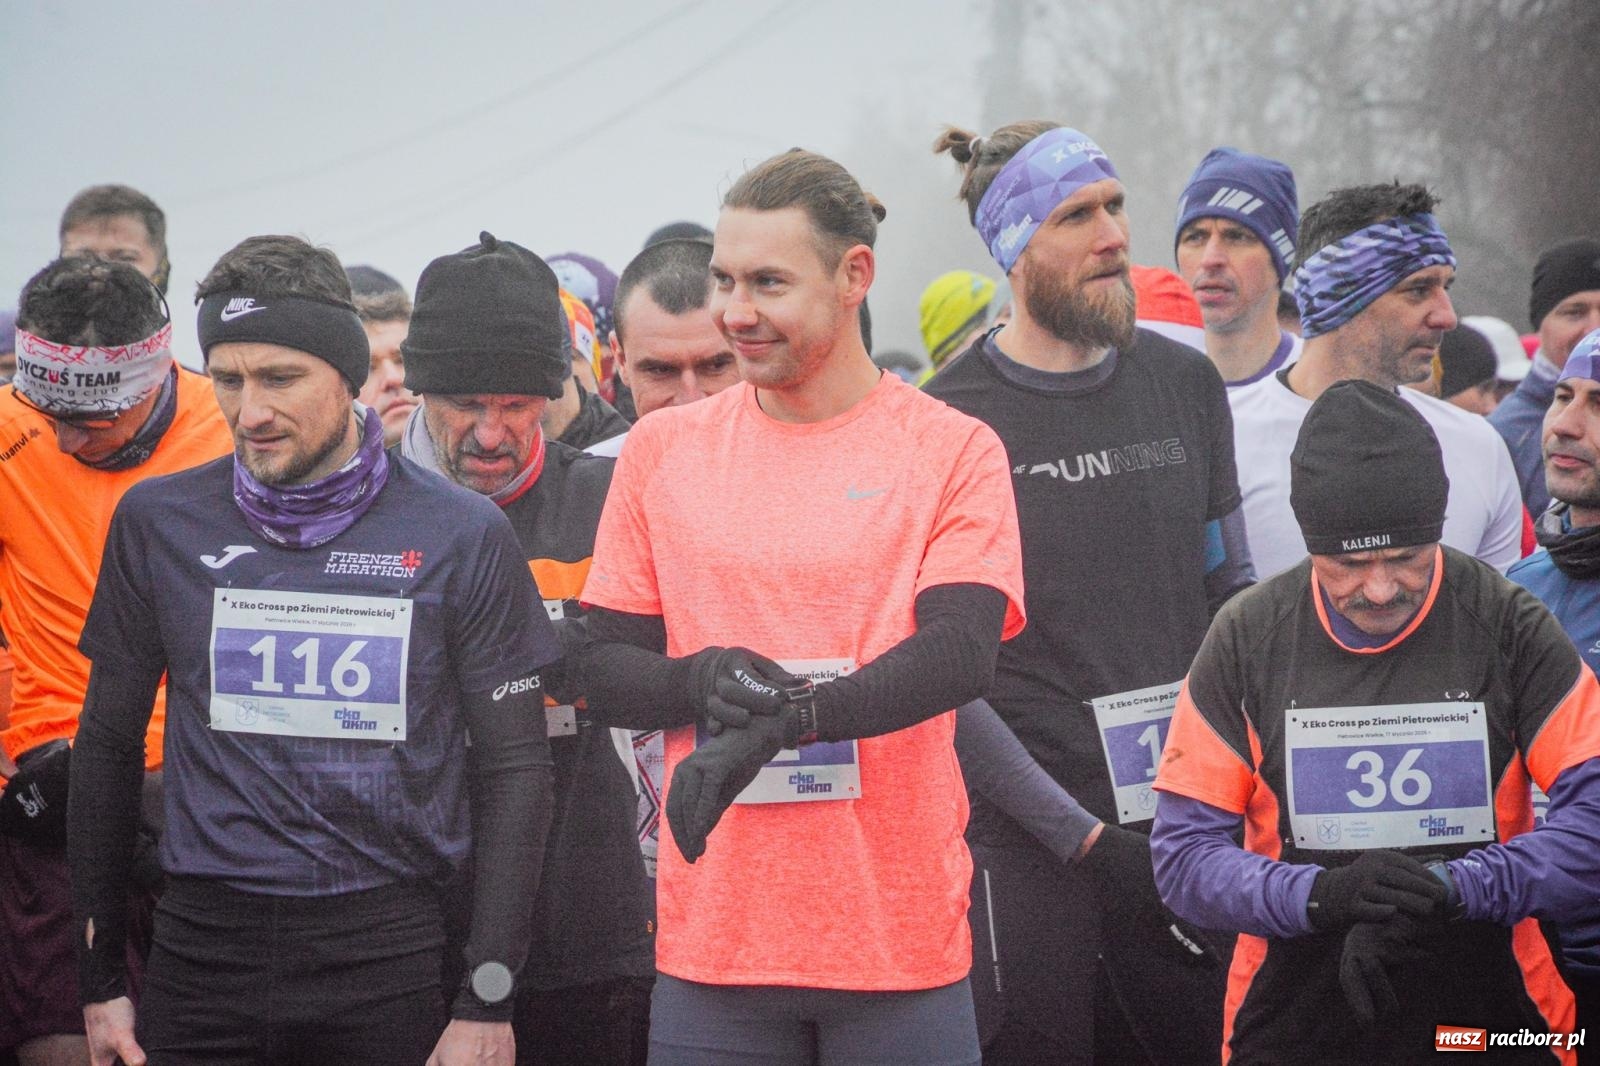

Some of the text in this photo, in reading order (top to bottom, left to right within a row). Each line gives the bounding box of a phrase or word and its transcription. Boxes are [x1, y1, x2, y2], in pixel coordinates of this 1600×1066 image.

[226, 297, 256, 312] NIKE
[74, 371, 121, 387] TEAM
[1342, 534, 1391, 551] KALENJI
[329, 551, 403, 566] FIRENZE
[324, 562, 416, 578] MARATHON
[230, 601, 396, 620] X Eko Cross po Ziemi Pietrowickiej
[248, 635, 371, 697] 116
[509, 675, 541, 694] asics
[1108, 702, 1116, 710] X
[1116, 699, 1133, 709] Eko
[1133, 696, 1159, 706] Cross
[1159, 693, 1169, 703] po
[334, 707, 361, 720] eko
[1302, 713, 1470, 729] X Eko Cross po Ziemi Pietrowickiej
[341, 720, 378, 730] okna
[1346, 748, 1432, 808] 36
[797, 783, 832, 794] okna
[1419, 814, 1447, 829] eko
[1428, 825, 1464, 837] okna
